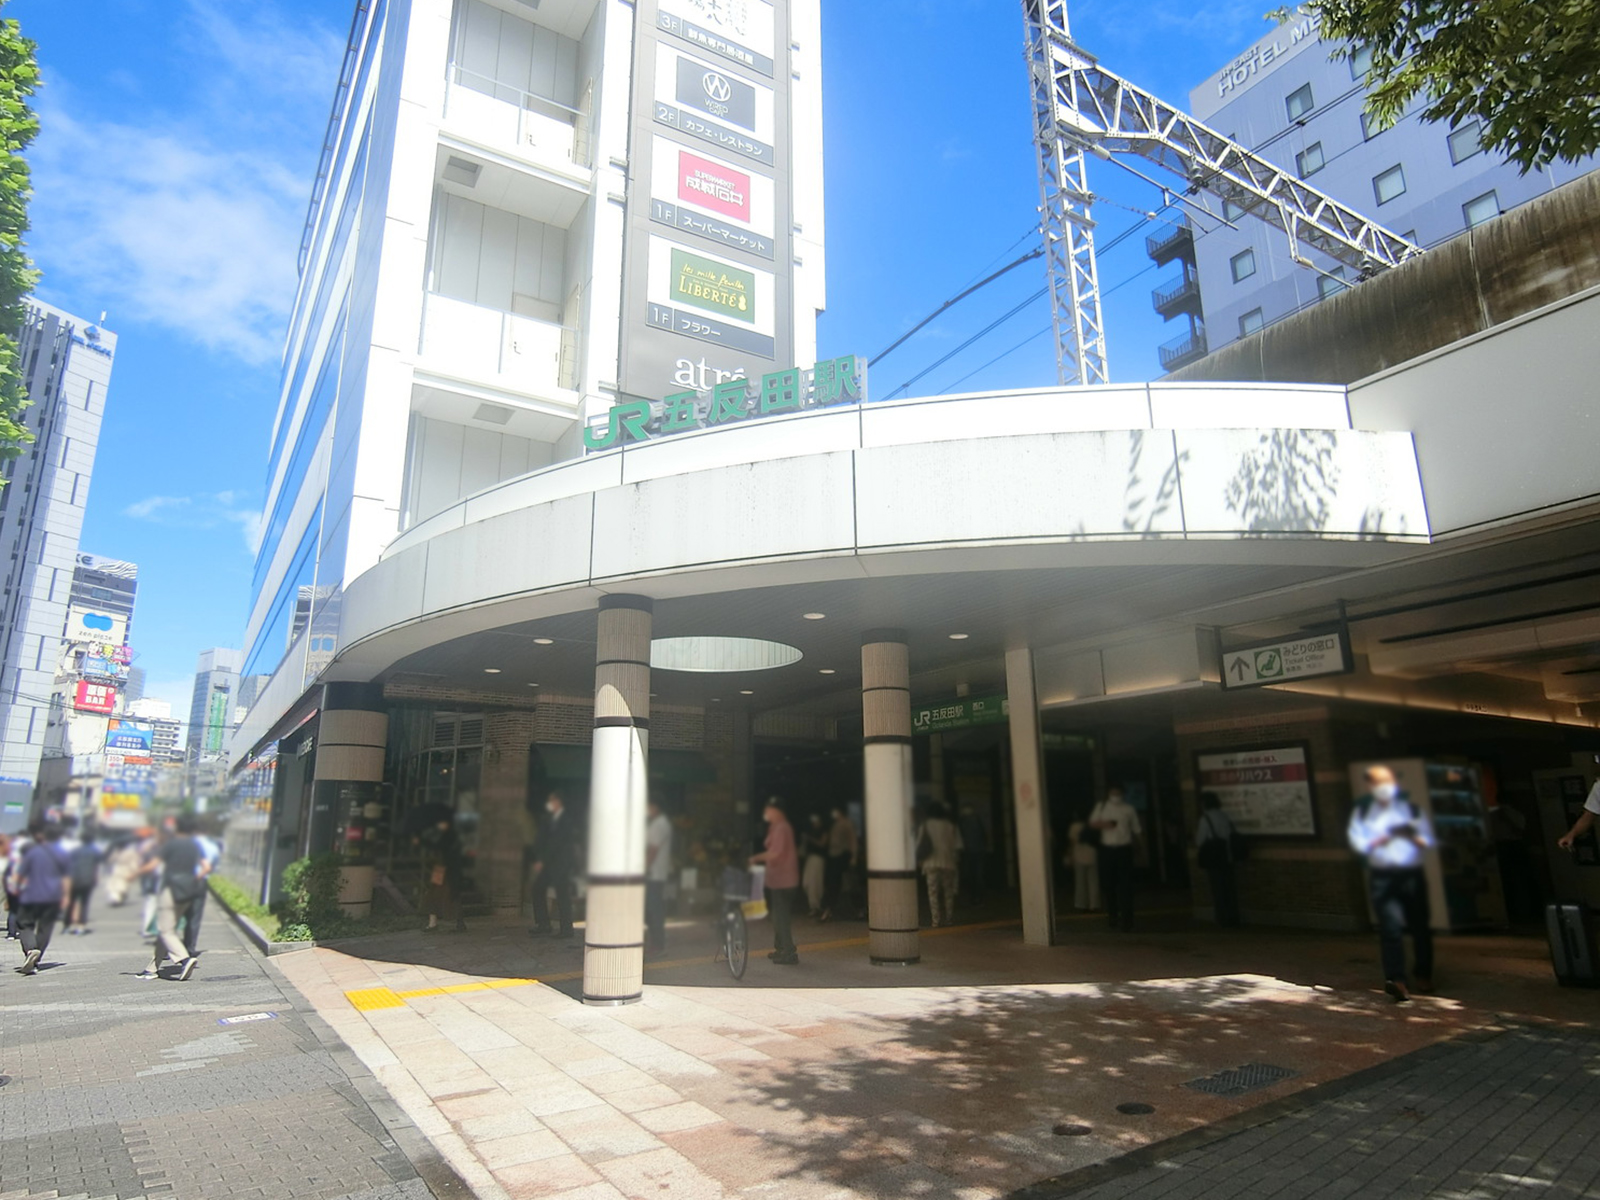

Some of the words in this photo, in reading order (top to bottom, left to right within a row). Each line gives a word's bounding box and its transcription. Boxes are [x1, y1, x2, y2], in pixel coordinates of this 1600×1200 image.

[661, 14, 678, 31] 3F
[1218, 42, 1288, 98] HOTEL
[658, 108, 675, 122] 2F
[686, 119, 763, 156] カフェ・レストラン
[686, 175, 743, 206] 成城石井
[657, 205, 672, 220] 1F
[683, 216, 765, 251] スーパーマーケット
[679, 275, 737, 307] LIBERTÉ
[653, 307, 669, 324] 1F
[681, 319, 721, 336] フラワー
[584, 400, 652, 448] JR
[660, 354, 858, 433] 五反田駅
[1283, 639, 1335, 657] みどりの窓口
[914, 710, 930, 726] JR
[932, 705, 964, 721] 五反田駅
